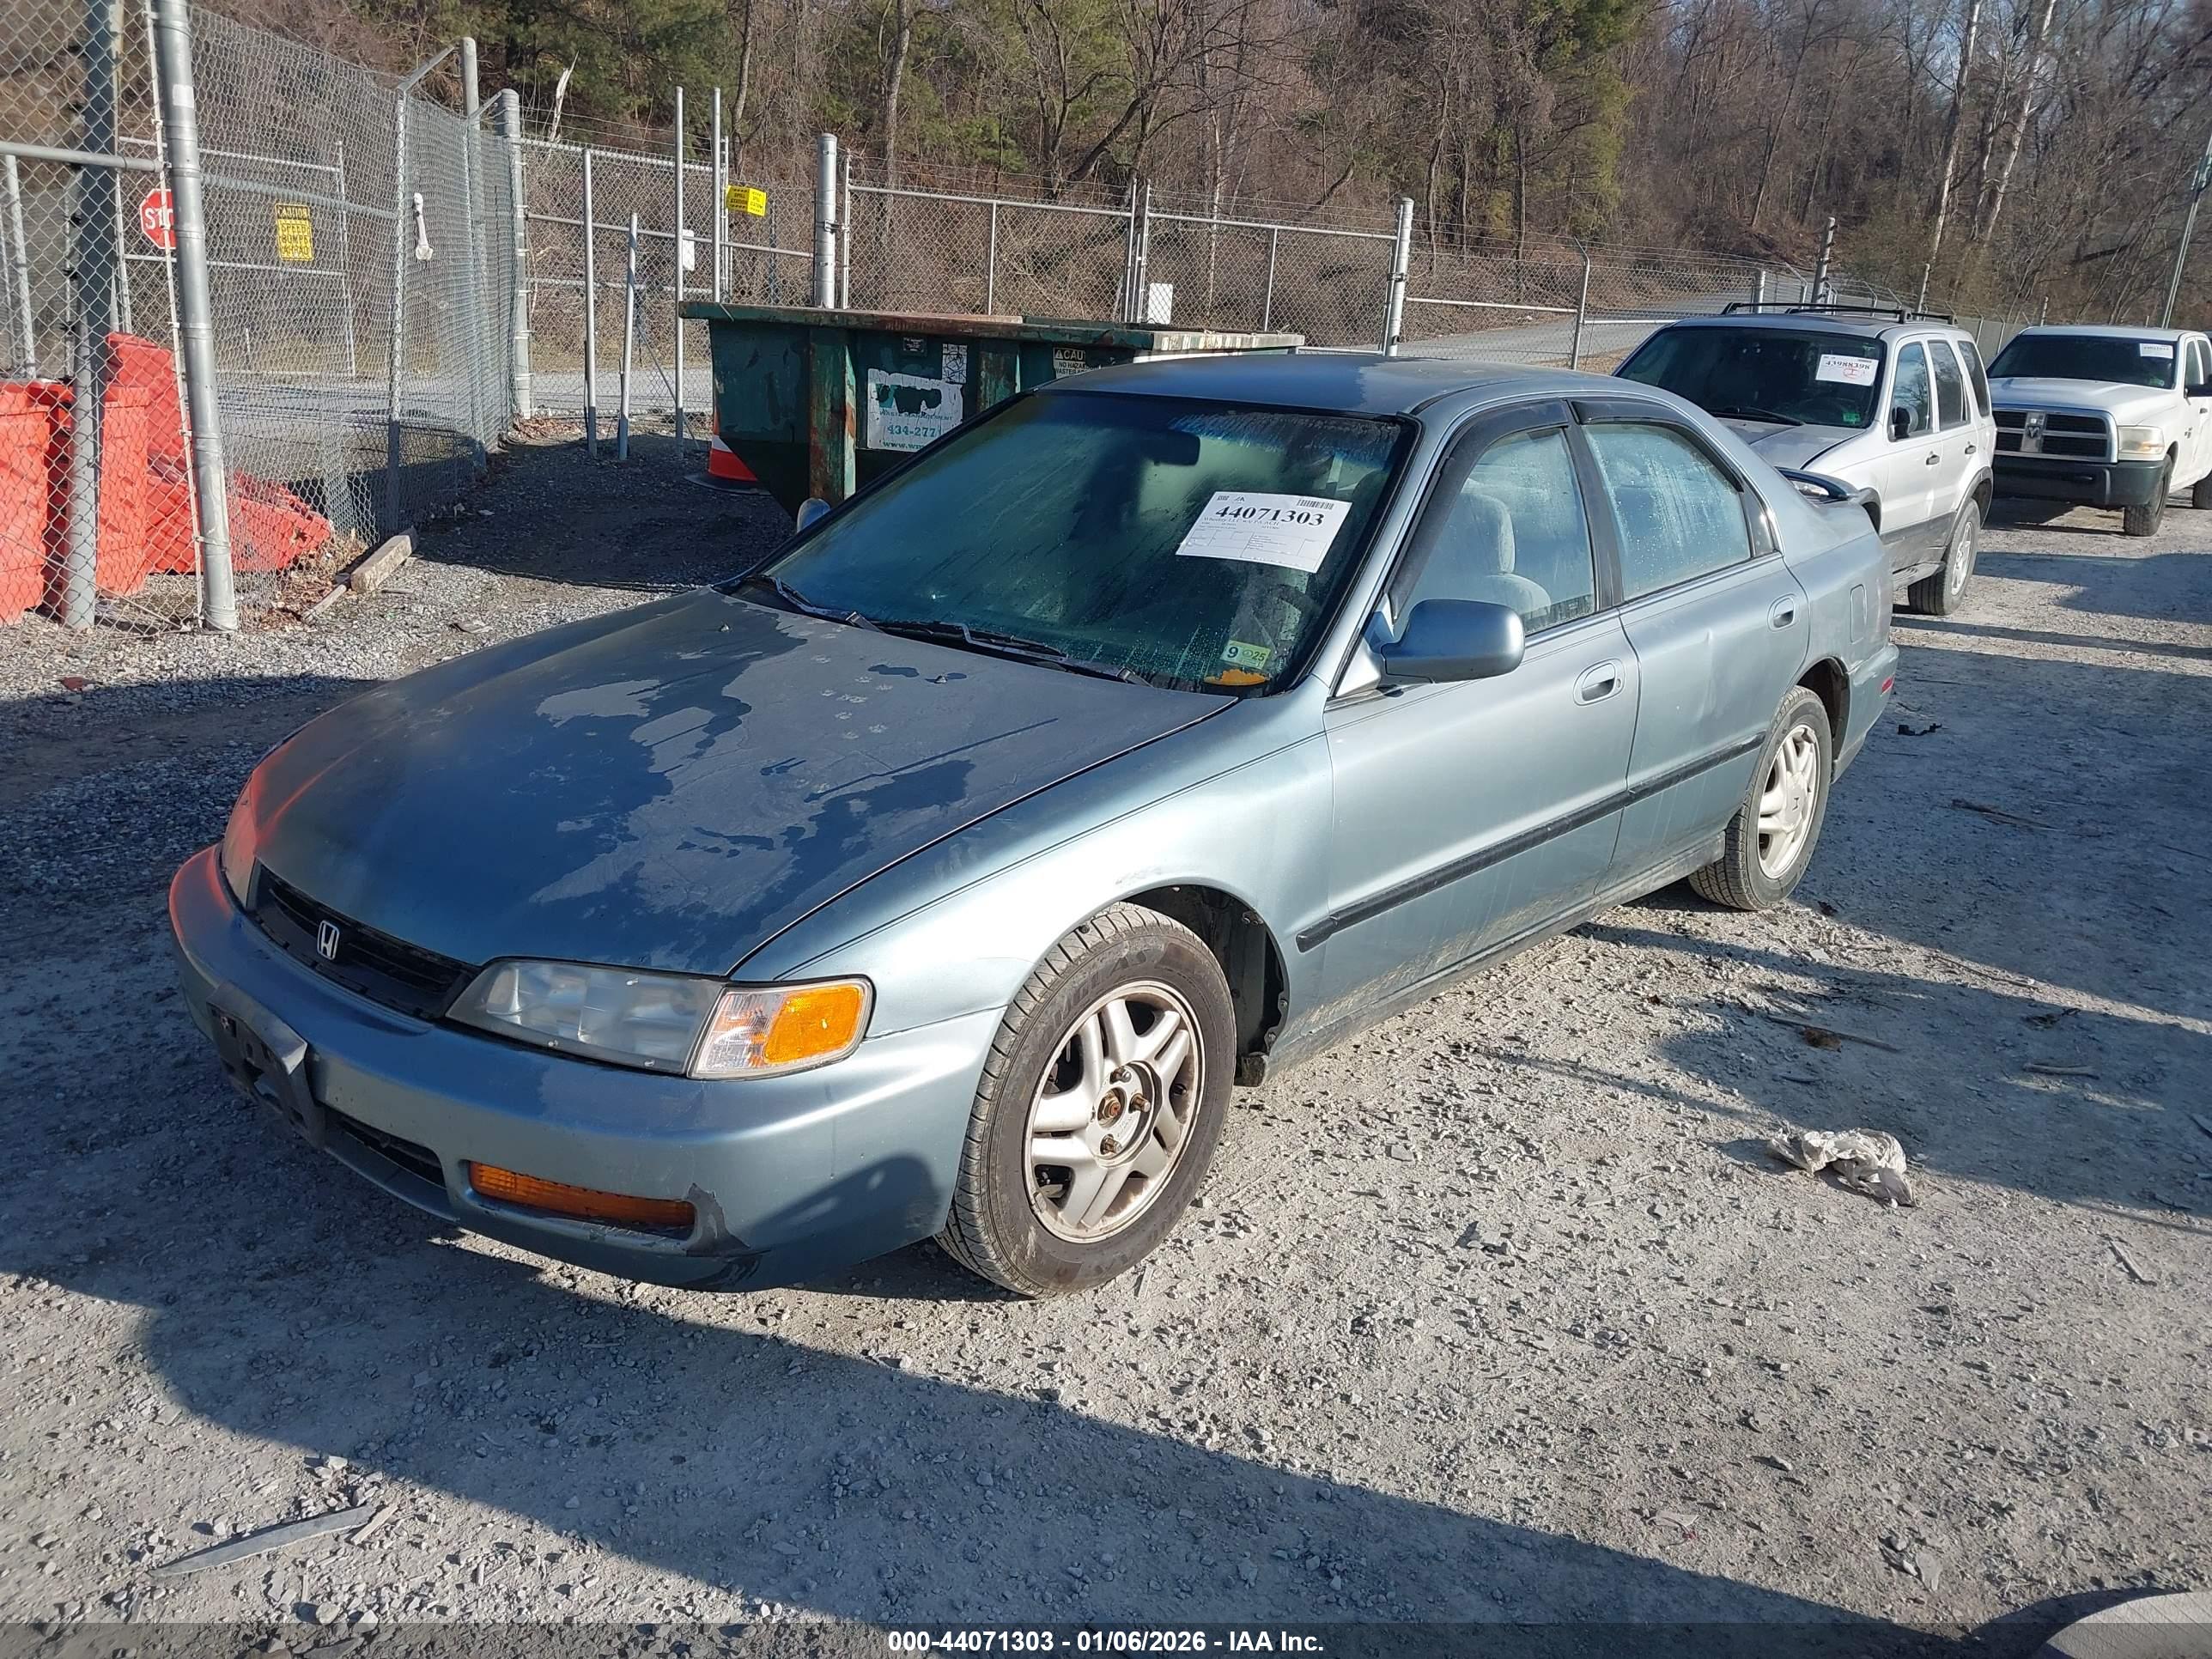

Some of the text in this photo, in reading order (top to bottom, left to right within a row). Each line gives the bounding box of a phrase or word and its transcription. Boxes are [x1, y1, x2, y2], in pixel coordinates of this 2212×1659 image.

[1063, 349, 1084, 361] CAU
[1215, 506, 1325, 526] 44071303
[1227, 647, 1266, 661] 9 25
